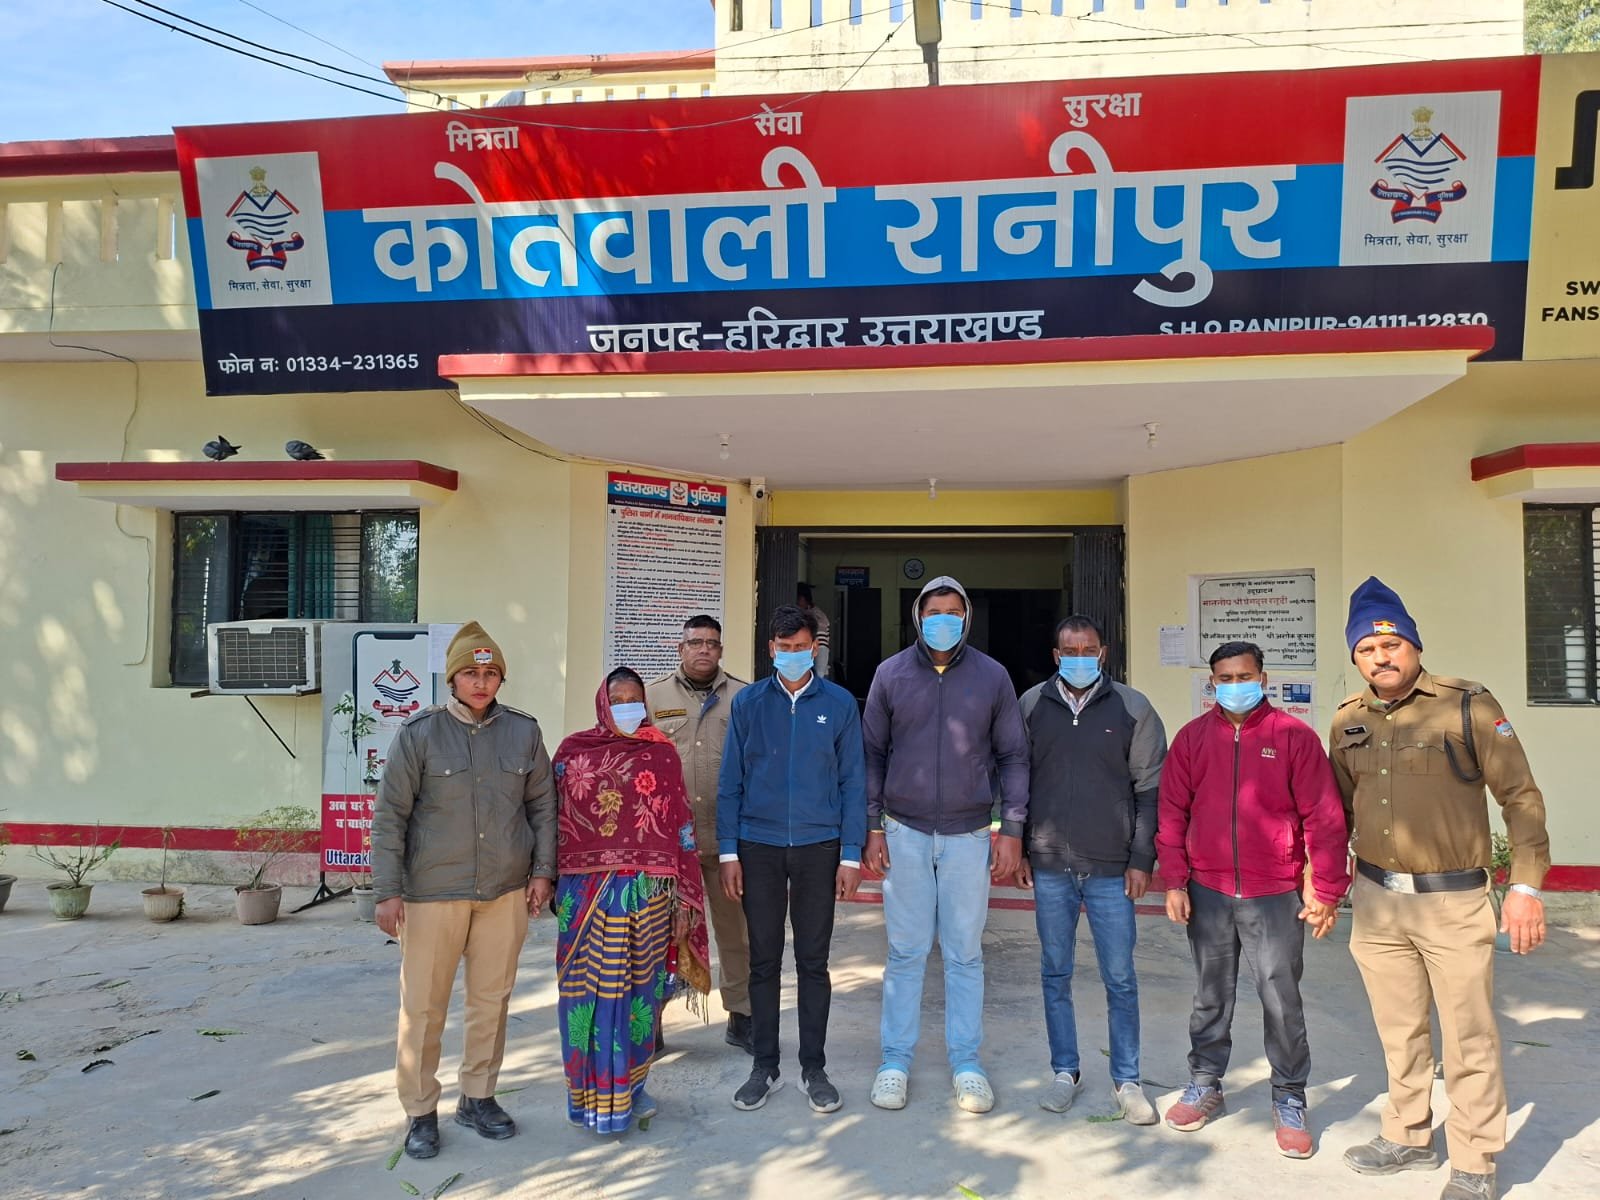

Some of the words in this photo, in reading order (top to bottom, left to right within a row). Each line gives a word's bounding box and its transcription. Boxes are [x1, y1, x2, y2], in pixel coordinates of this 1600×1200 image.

[754, 102, 803, 136] सेवा
[1062, 92, 1142, 128] सुरक्षा
[446, 121, 519, 152] मित्रता
[362, 146, 836, 292] कोतवाली
[875, 131, 1297, 308] रानीपुर
[1364, 233, 1401, 247] मित्रता,
[1406, 232, 1432, 246] सेवा,
[1436, 232, 1468, 248] सुरक्षा
[228, 279, 259, 292] मित्रता,
[262, 278, 283, 290] सेवा,
[286, 278, 312, 292] सुरक्षा
[1542, 306, 1600, 322] FANS
[860, 310, 1045, 347] उत्तराखण्ड
[218, 353, 254, 375] फोन
[286, 353, 419, 372] 01334-231365
[613, 479, 668, 498] उत्तराखण्ड
[690, 486, 721, 506] पुलिस
[325, 849, 371, 865] Uttarak
